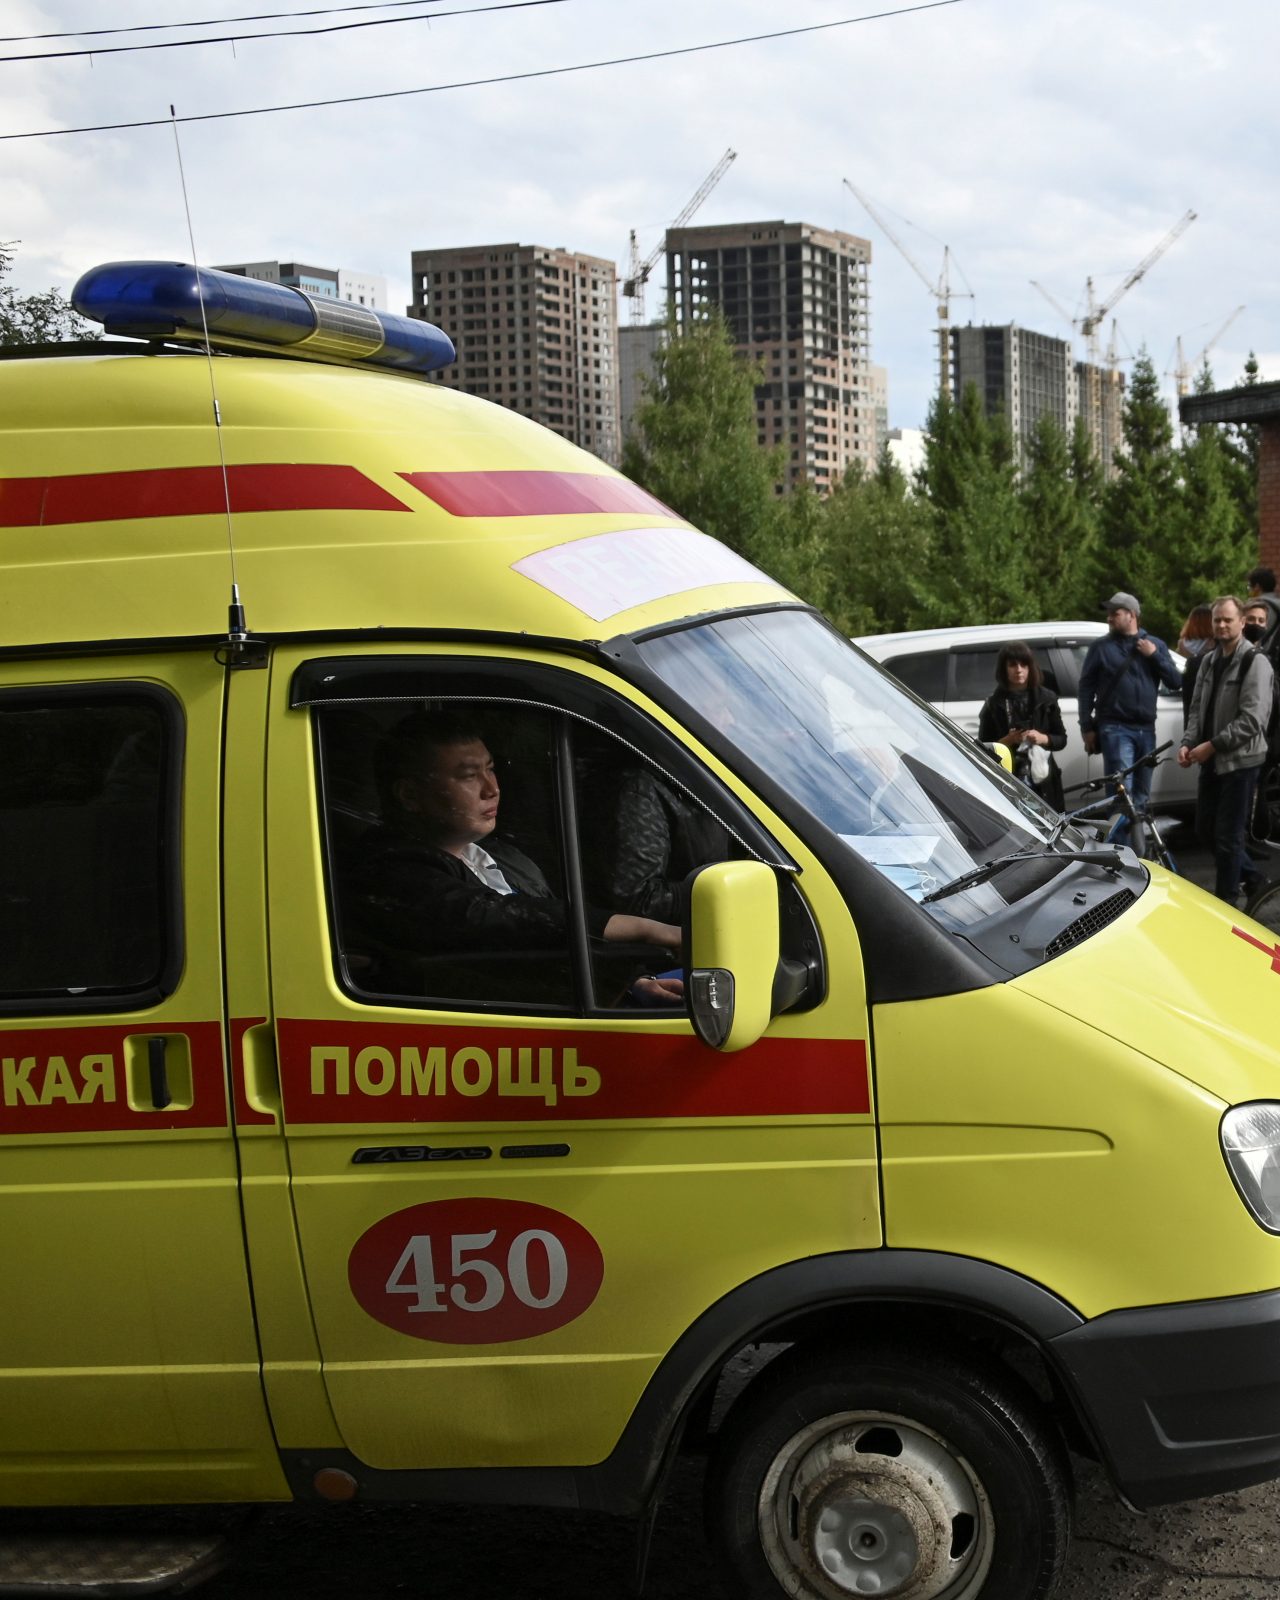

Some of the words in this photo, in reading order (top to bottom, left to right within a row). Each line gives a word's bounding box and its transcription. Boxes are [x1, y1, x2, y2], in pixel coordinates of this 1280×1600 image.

[2, 1054, 116, 1106] КАЯ
[310, 1046, 601, 1106] ПОМОЩЬ
[385, 1229, 568, 1313] 450
